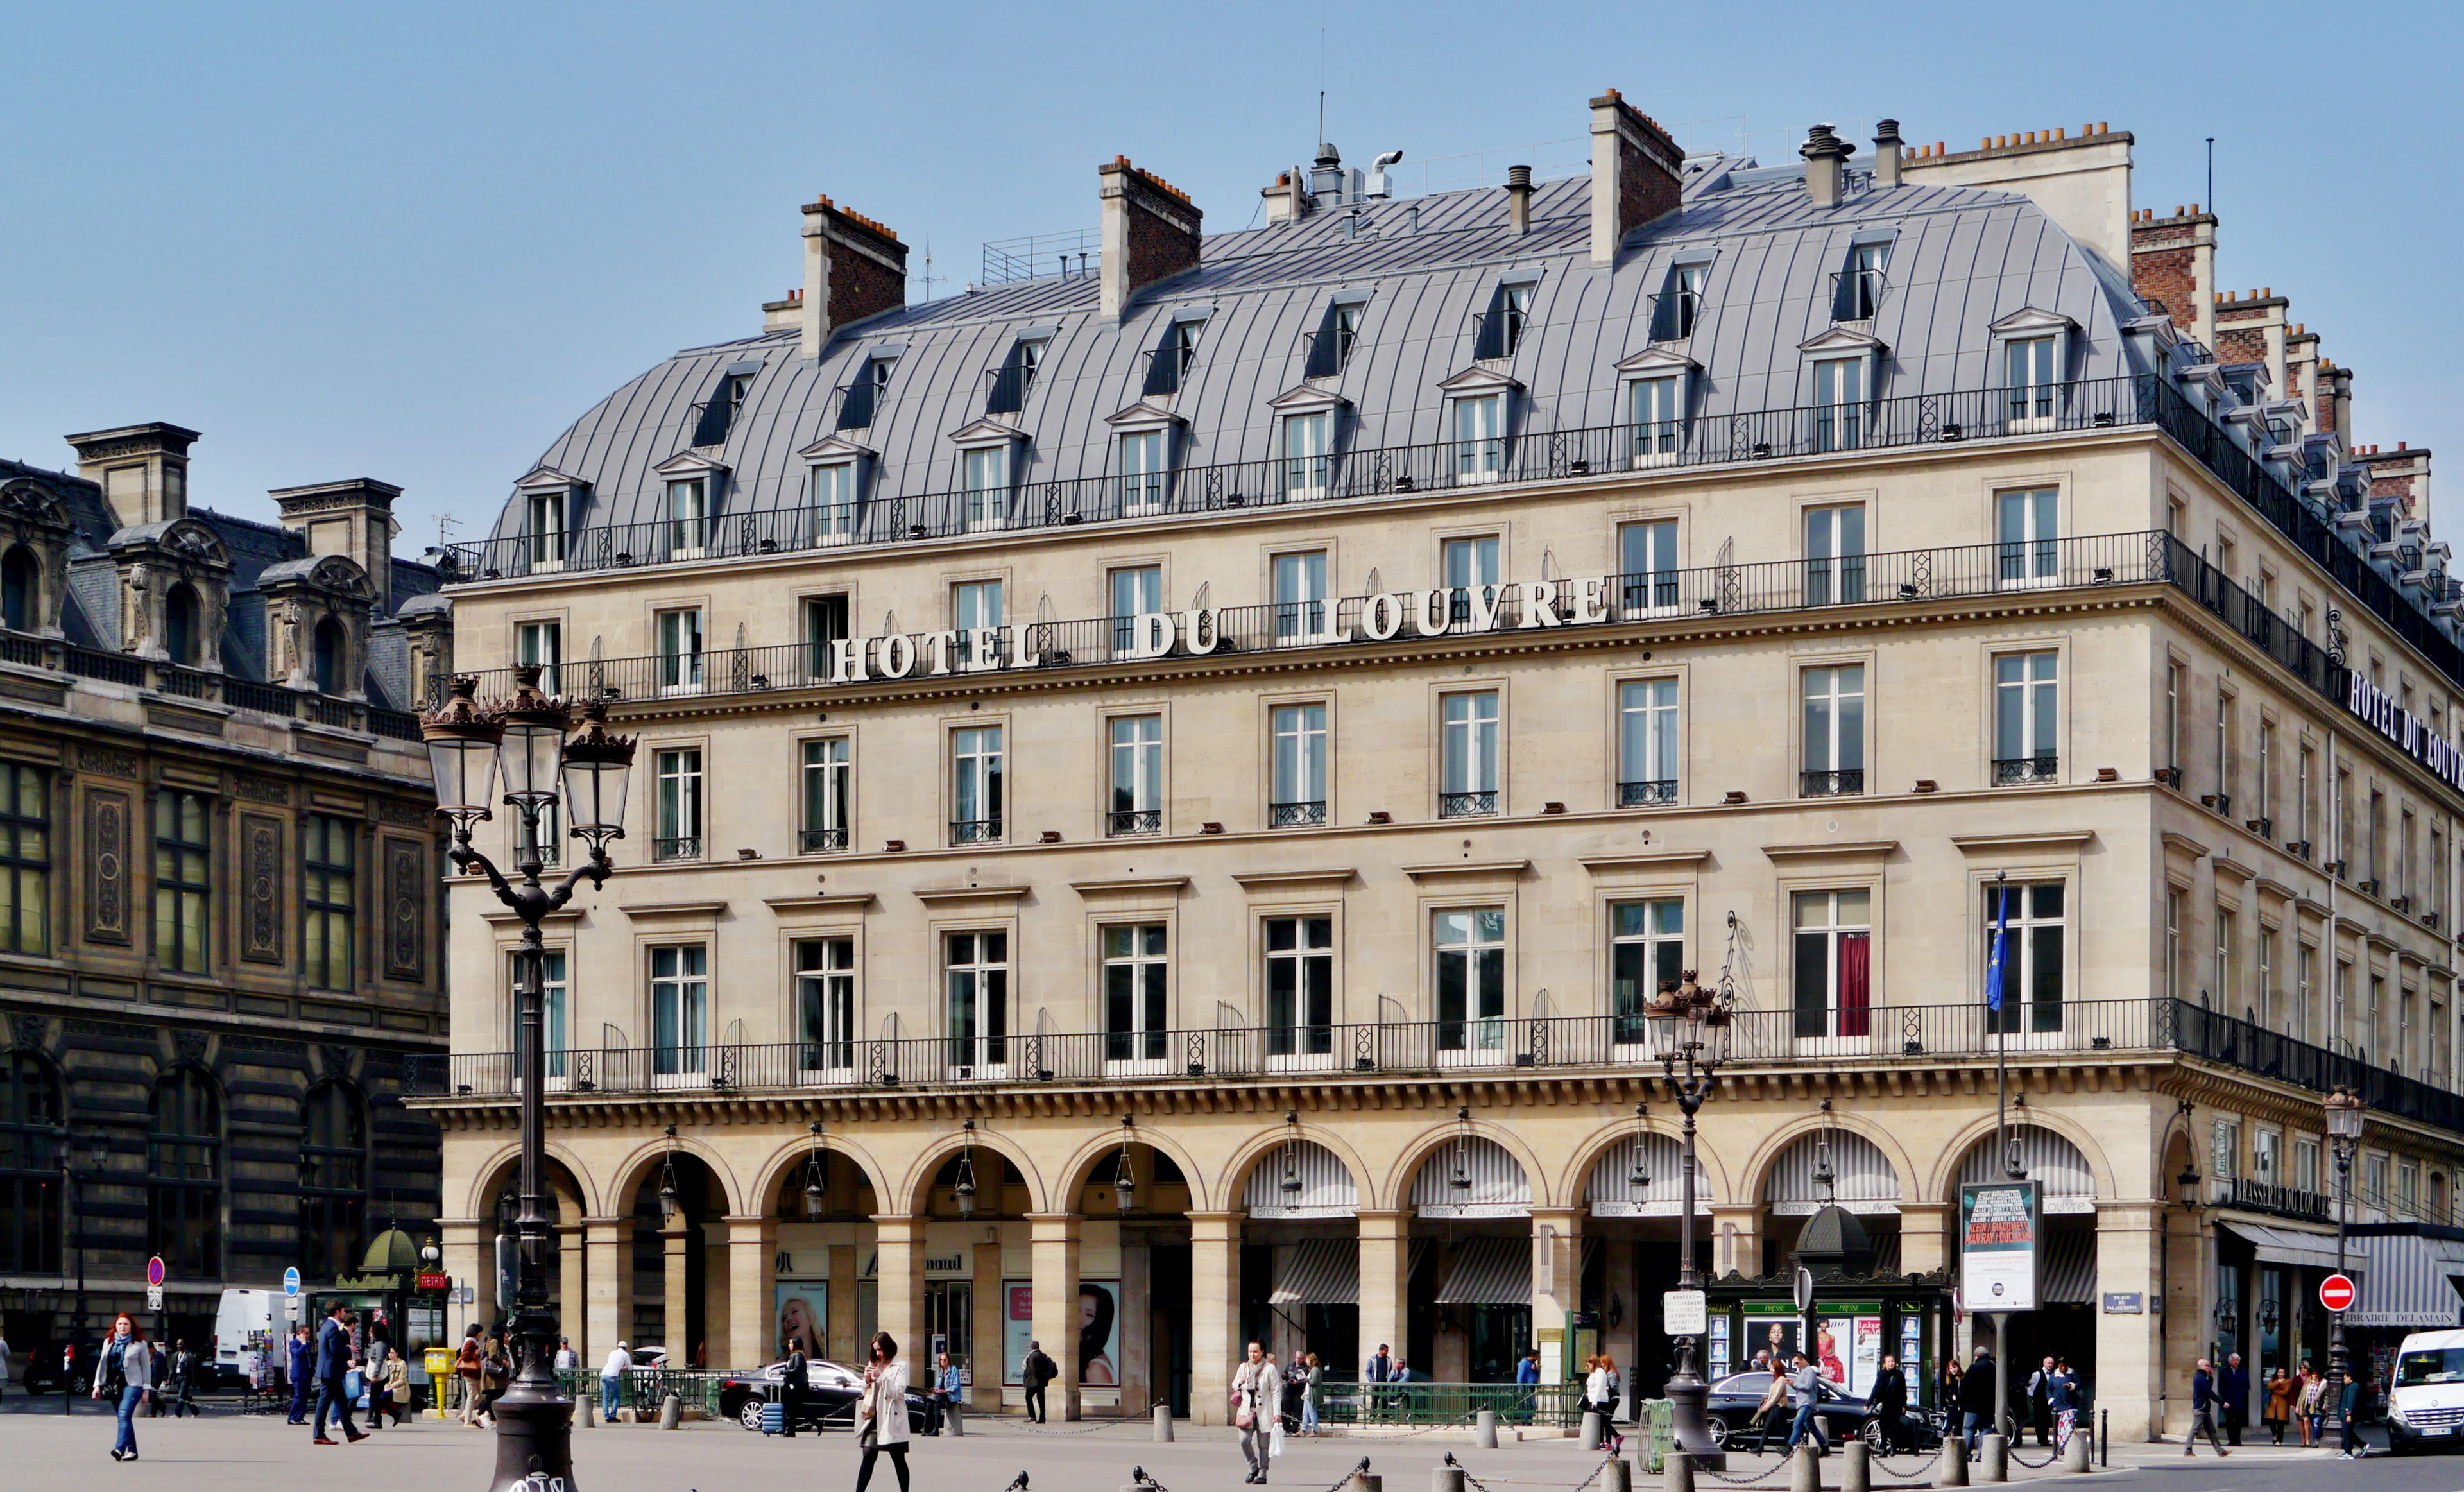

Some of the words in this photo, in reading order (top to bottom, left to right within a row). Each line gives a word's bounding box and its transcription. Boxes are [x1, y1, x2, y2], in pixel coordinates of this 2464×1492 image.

[831, 624, 1040, 682] HOTEL
[1135, 608, 1222, 658] DU
[1321, 576, 1609, 644] LOUVRE
[2350, 669, 2397, 741] HOTEL
[2403, 708, 2419, 759] DU
[2236, 1178, 2282, 1210] BRASSERIE
[2286, 1188, 2297, 1212] DU
[2299, 1189, 2331, 1216] LOUVRE
[1308, 1206, 1319, 1216] du
[1478, 1206, 1490, 1215] du
[1654, 1205, 1666, 1215] du
[1969, 1222, 1987, 1232] KLEIN
[1965, 1232, 1981, 1244] MAN
[1981, 1232, 1994, 1244] RAY
[421, 1276, 445, 1286] METRO
[1707, 1303, 1729, 1312] PRESSE
[2344, 1314, 2390, 1322] IBRAIRIE
[2396, 1314, 2452, 1322] DELAMAIN
